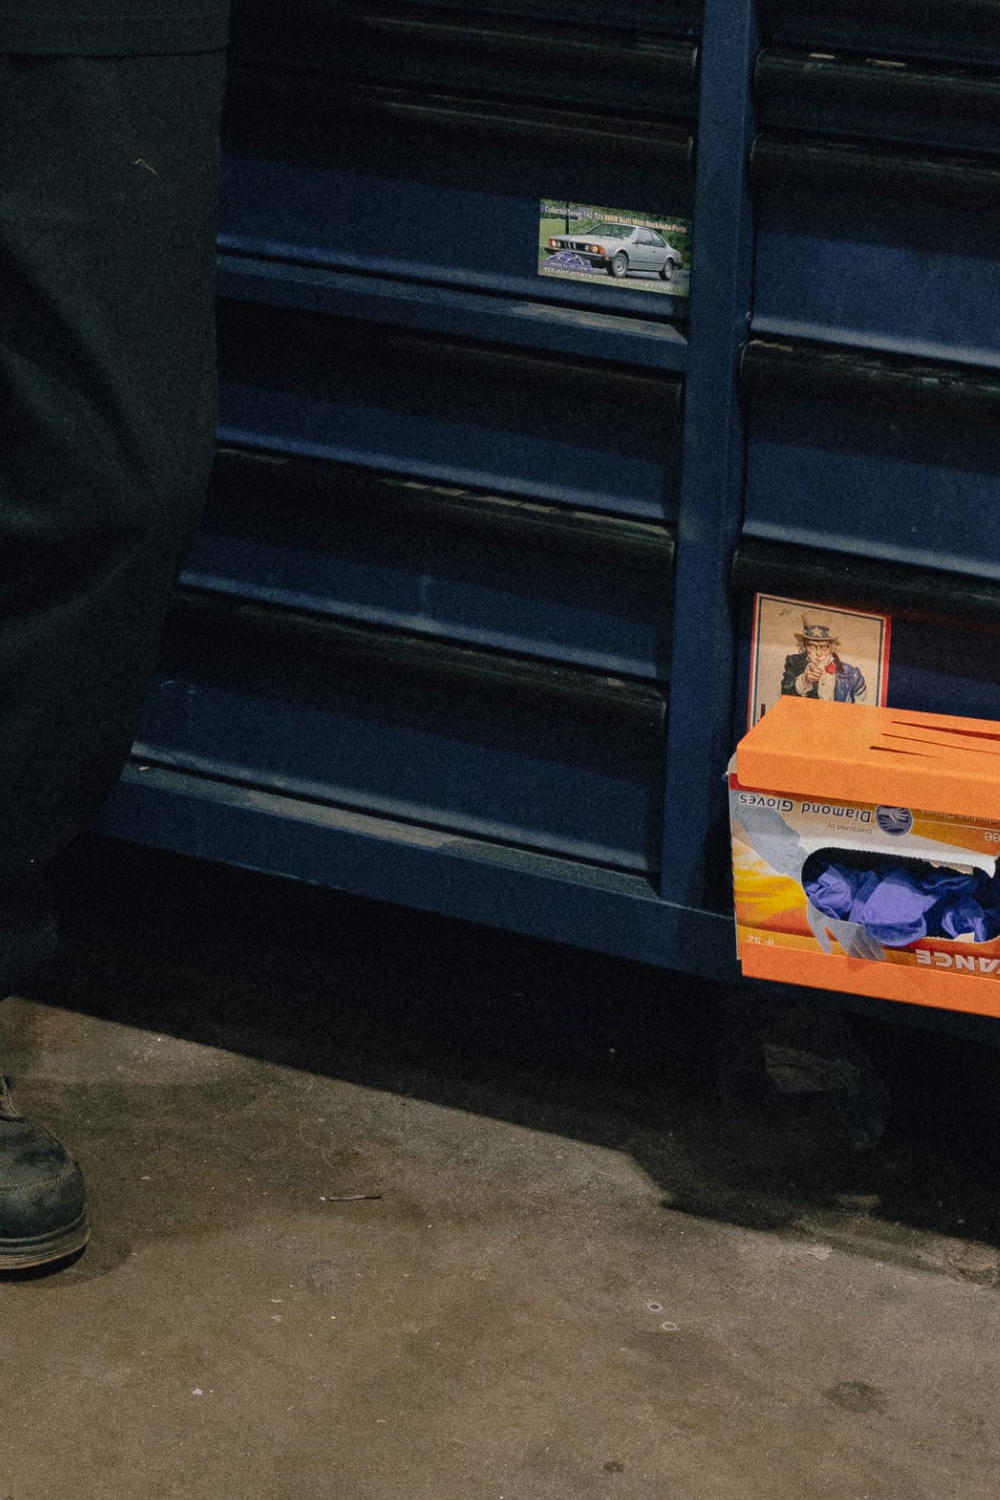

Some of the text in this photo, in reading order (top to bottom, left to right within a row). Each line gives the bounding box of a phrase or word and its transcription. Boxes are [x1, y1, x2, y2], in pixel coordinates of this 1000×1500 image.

[739, 794, 872, 823] Diamond Gloves
[915, 948, 1000, 976] ANCE
